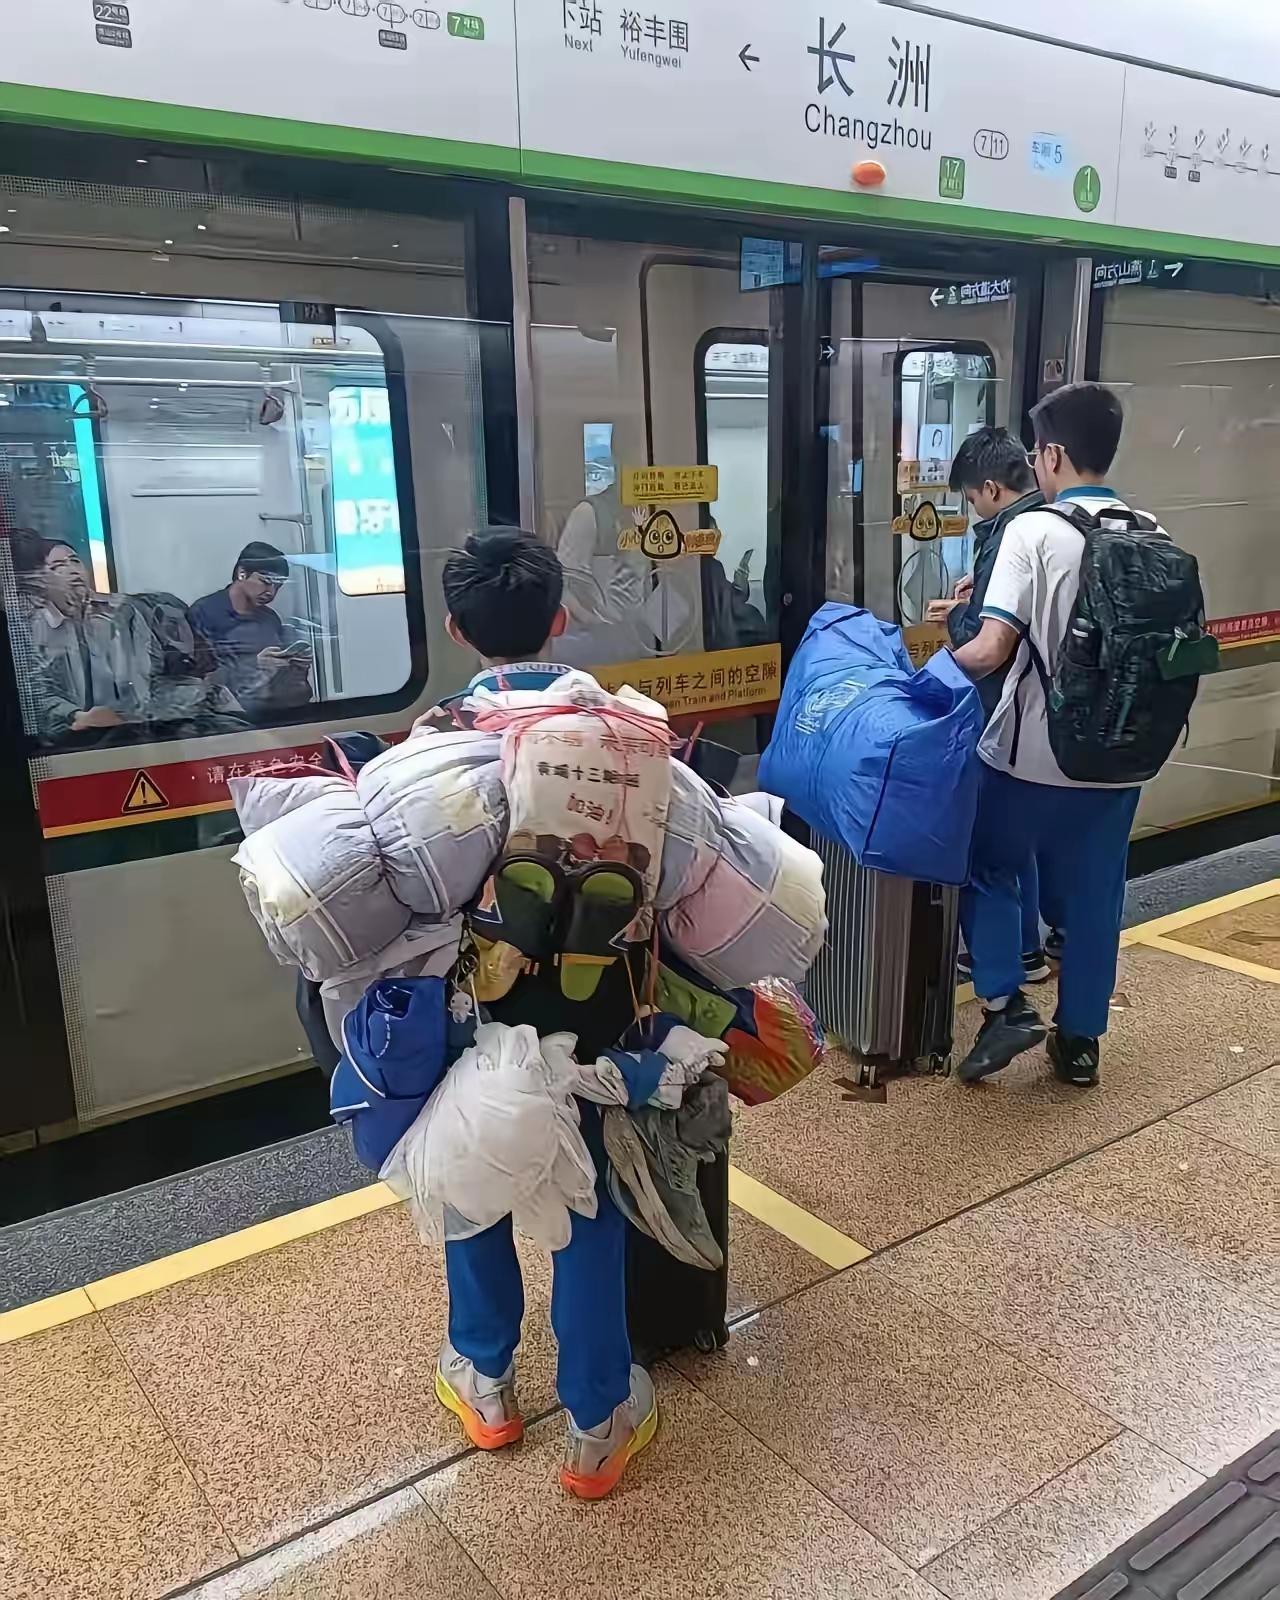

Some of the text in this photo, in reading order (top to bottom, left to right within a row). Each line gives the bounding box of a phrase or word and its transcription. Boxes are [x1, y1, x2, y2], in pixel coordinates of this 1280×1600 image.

[564, 34, 593, 52] Next
[620, 8, 688, 52] 裕丰围
[621, 44, 682, 69] Yufengwei
[807, 16, 931, 113] 长洲
[805, 103, 932, 151] Changzhou
[944, 160, 960, 178] 17
[603, 661, 777, 697] 与列车之间的空隙
[684, 695, 707, 706] Train
[709, 691, 726, 703] and
[728, 687, 767, 700] Platform
